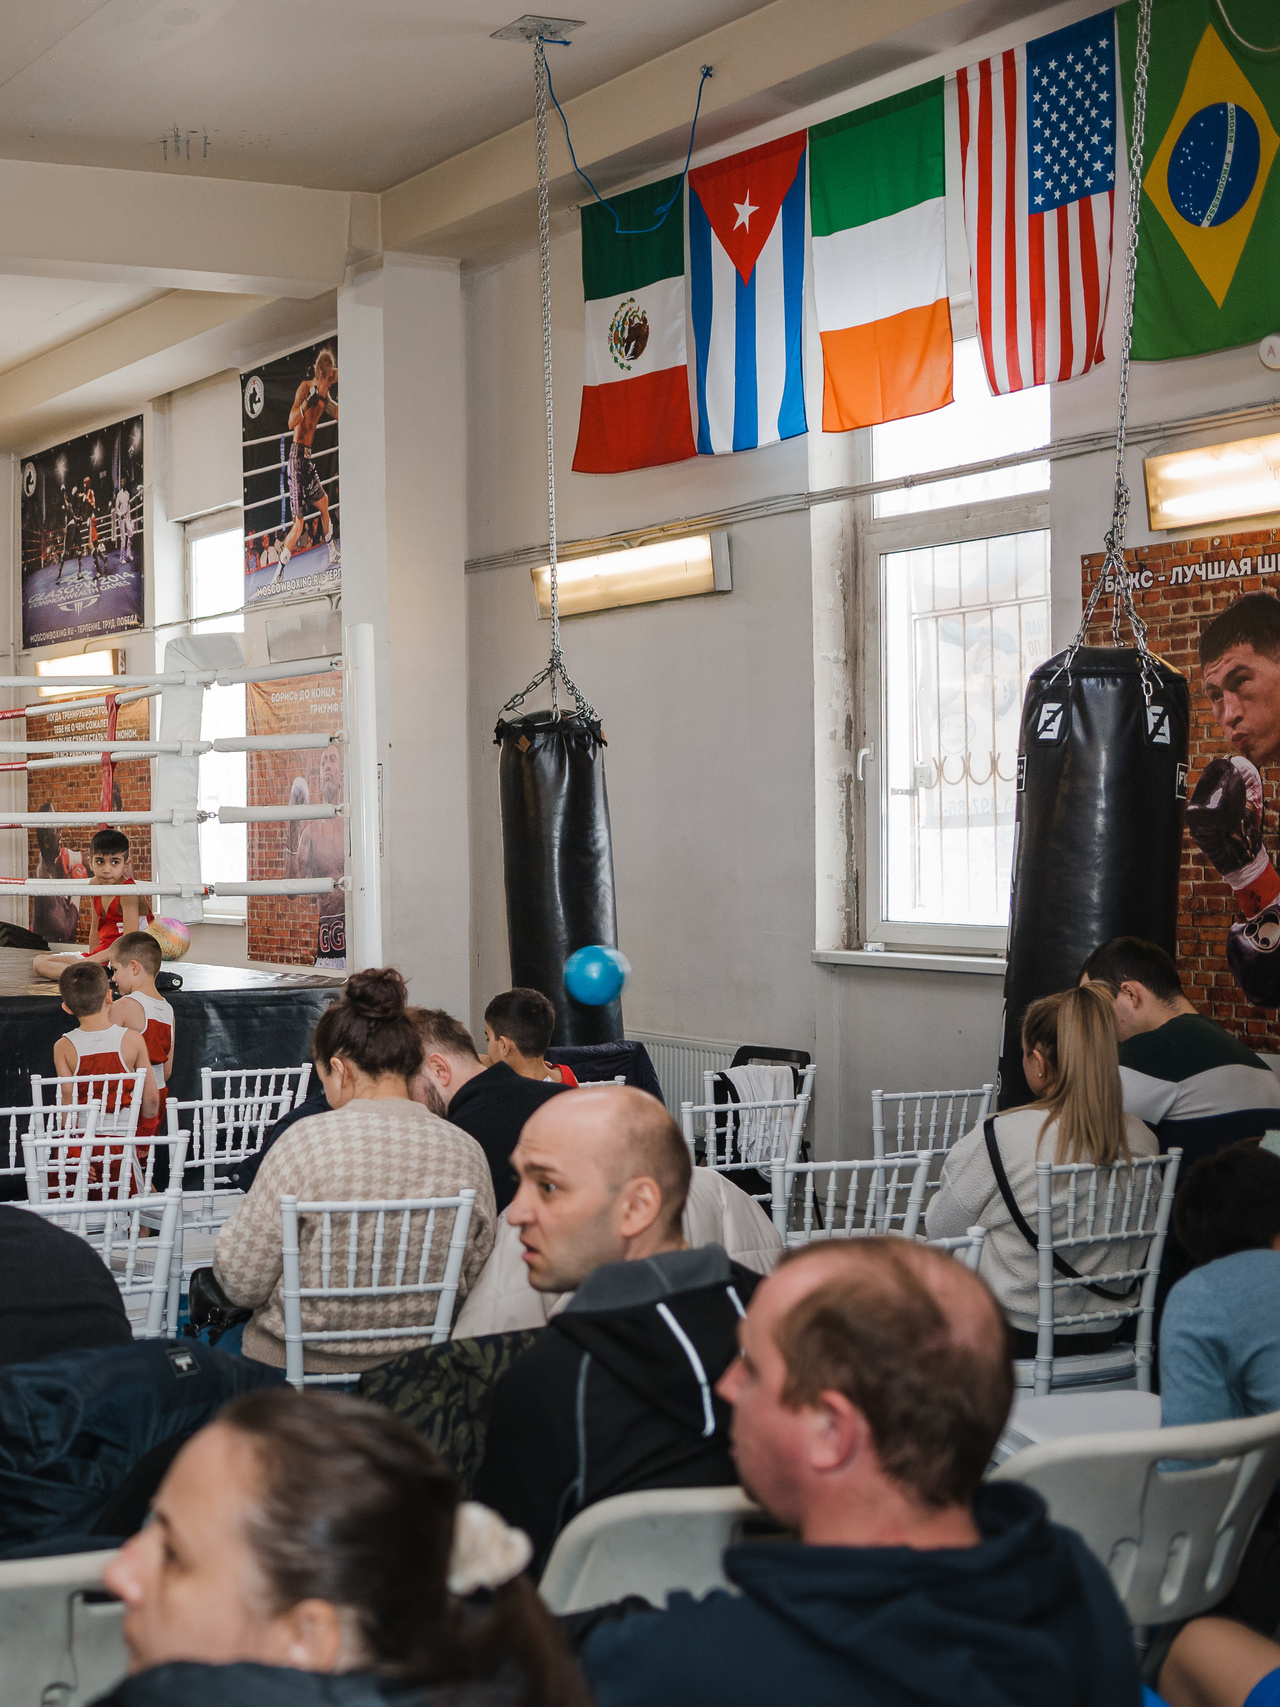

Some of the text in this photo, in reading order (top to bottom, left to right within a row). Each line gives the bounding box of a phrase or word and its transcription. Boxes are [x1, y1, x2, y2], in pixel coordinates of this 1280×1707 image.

[1205, 161, 1230, 222] PROGRESSO
[256, 572, 322, 599] MOSCOWBOXING.RU
[1105, 570, 1154, 593] БКС
[1170, 557, 1252, 585] ЛУЧШАЯ
[1257, 553, 1280, 574] Ш
[28, 571, 136, 604] GLASGOW 2014
[29, 580, 131, 609] COMMONWEALTH GAMES
[29, 626, 75, 643] MOSCOWBOXING.RU
[271, 690, 298, 704] БОРИСЬ
[299, 687, 310, 702] ДО
[311, 685, 336, 700] КОНЦА
[310, 702, 339, 715] ТРИУМФ
